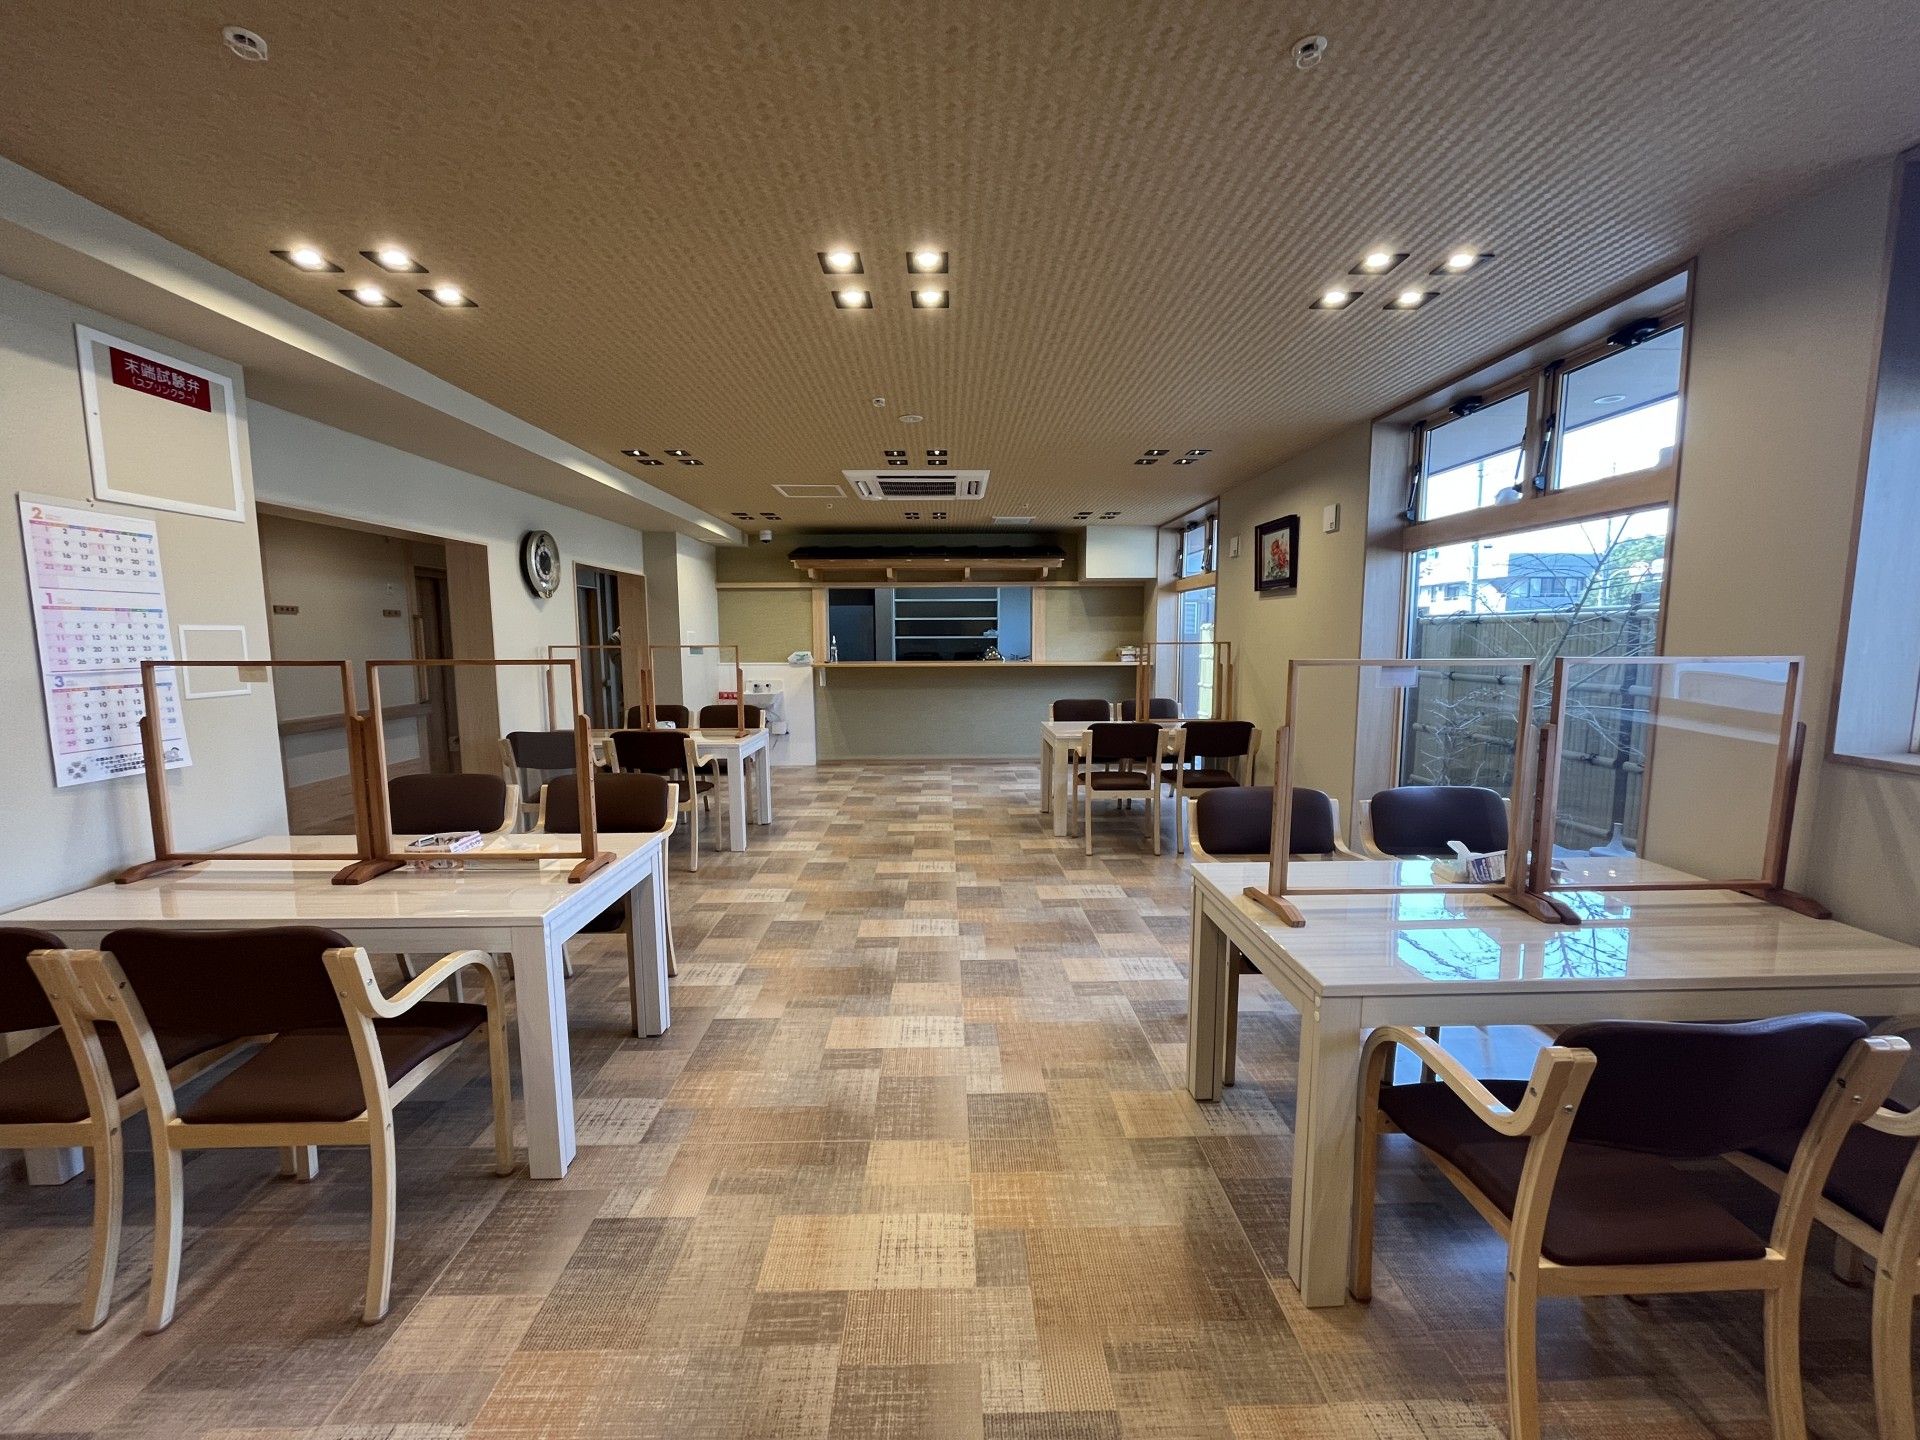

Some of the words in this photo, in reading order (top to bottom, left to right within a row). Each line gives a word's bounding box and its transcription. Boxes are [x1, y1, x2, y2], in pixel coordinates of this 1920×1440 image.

[123, 358, 200, 394] 末端試験弁
